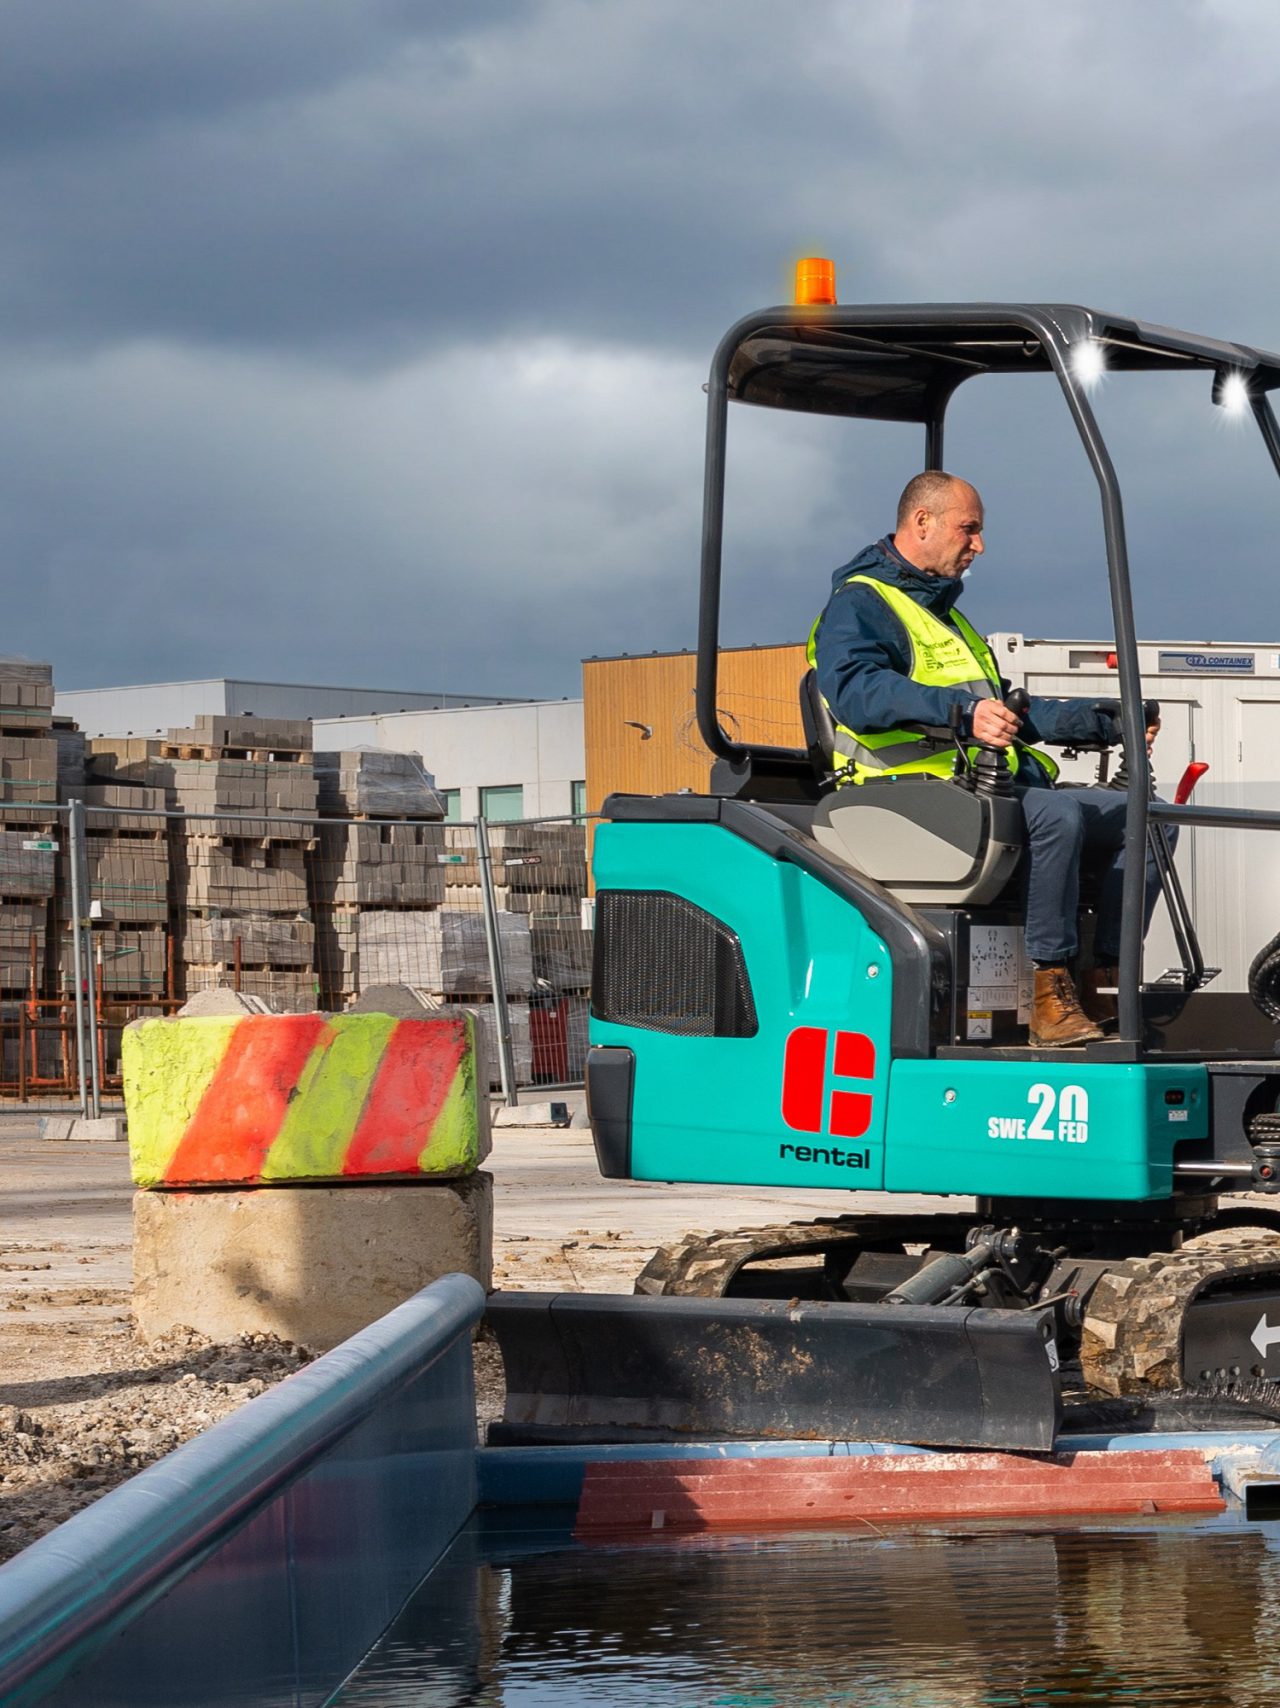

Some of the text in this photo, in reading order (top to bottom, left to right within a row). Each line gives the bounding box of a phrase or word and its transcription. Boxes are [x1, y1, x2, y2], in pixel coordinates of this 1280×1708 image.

[1208, 656, 1253, 666] CONTAINEX
[987, 1116, 1026, 1140] SWE
[1058, 1121, 1089, 1143] FED
[780, 1143, 870, 1170] rental
